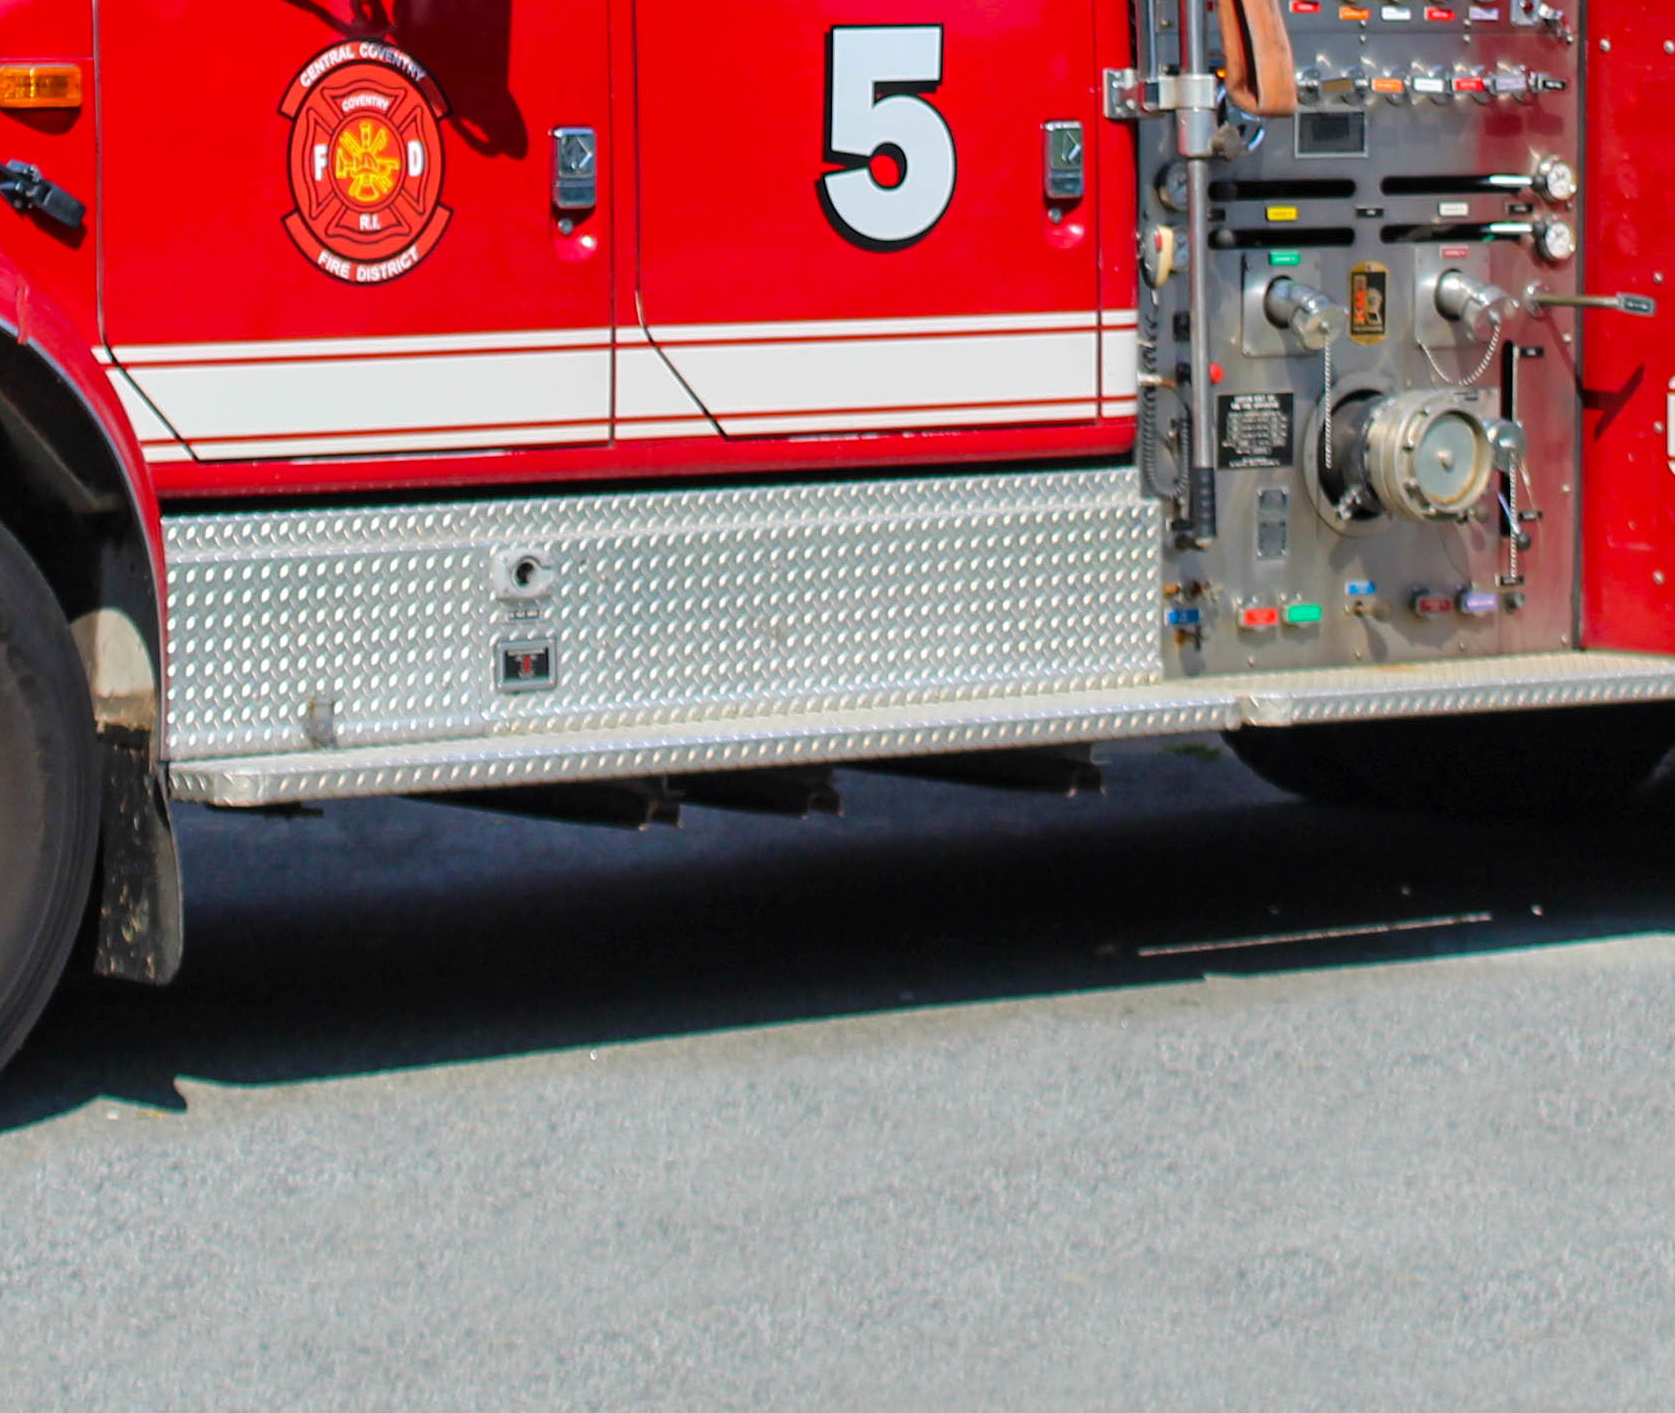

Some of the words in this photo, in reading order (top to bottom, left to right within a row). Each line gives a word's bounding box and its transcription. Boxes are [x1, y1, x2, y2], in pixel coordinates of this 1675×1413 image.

[299, 43, 354, 87] CENTRAL
[359, 42, 426, 81] COVENTRY
[341, 94, 390, 112] COVENTRY
[816, 24, 957, 253] 5
[313, 143, 329, 181] F
[406, 140, 425, 177] D
[317, 250, 350, 279] FIRE
[357, 247, 419, 281] DISTRICT
